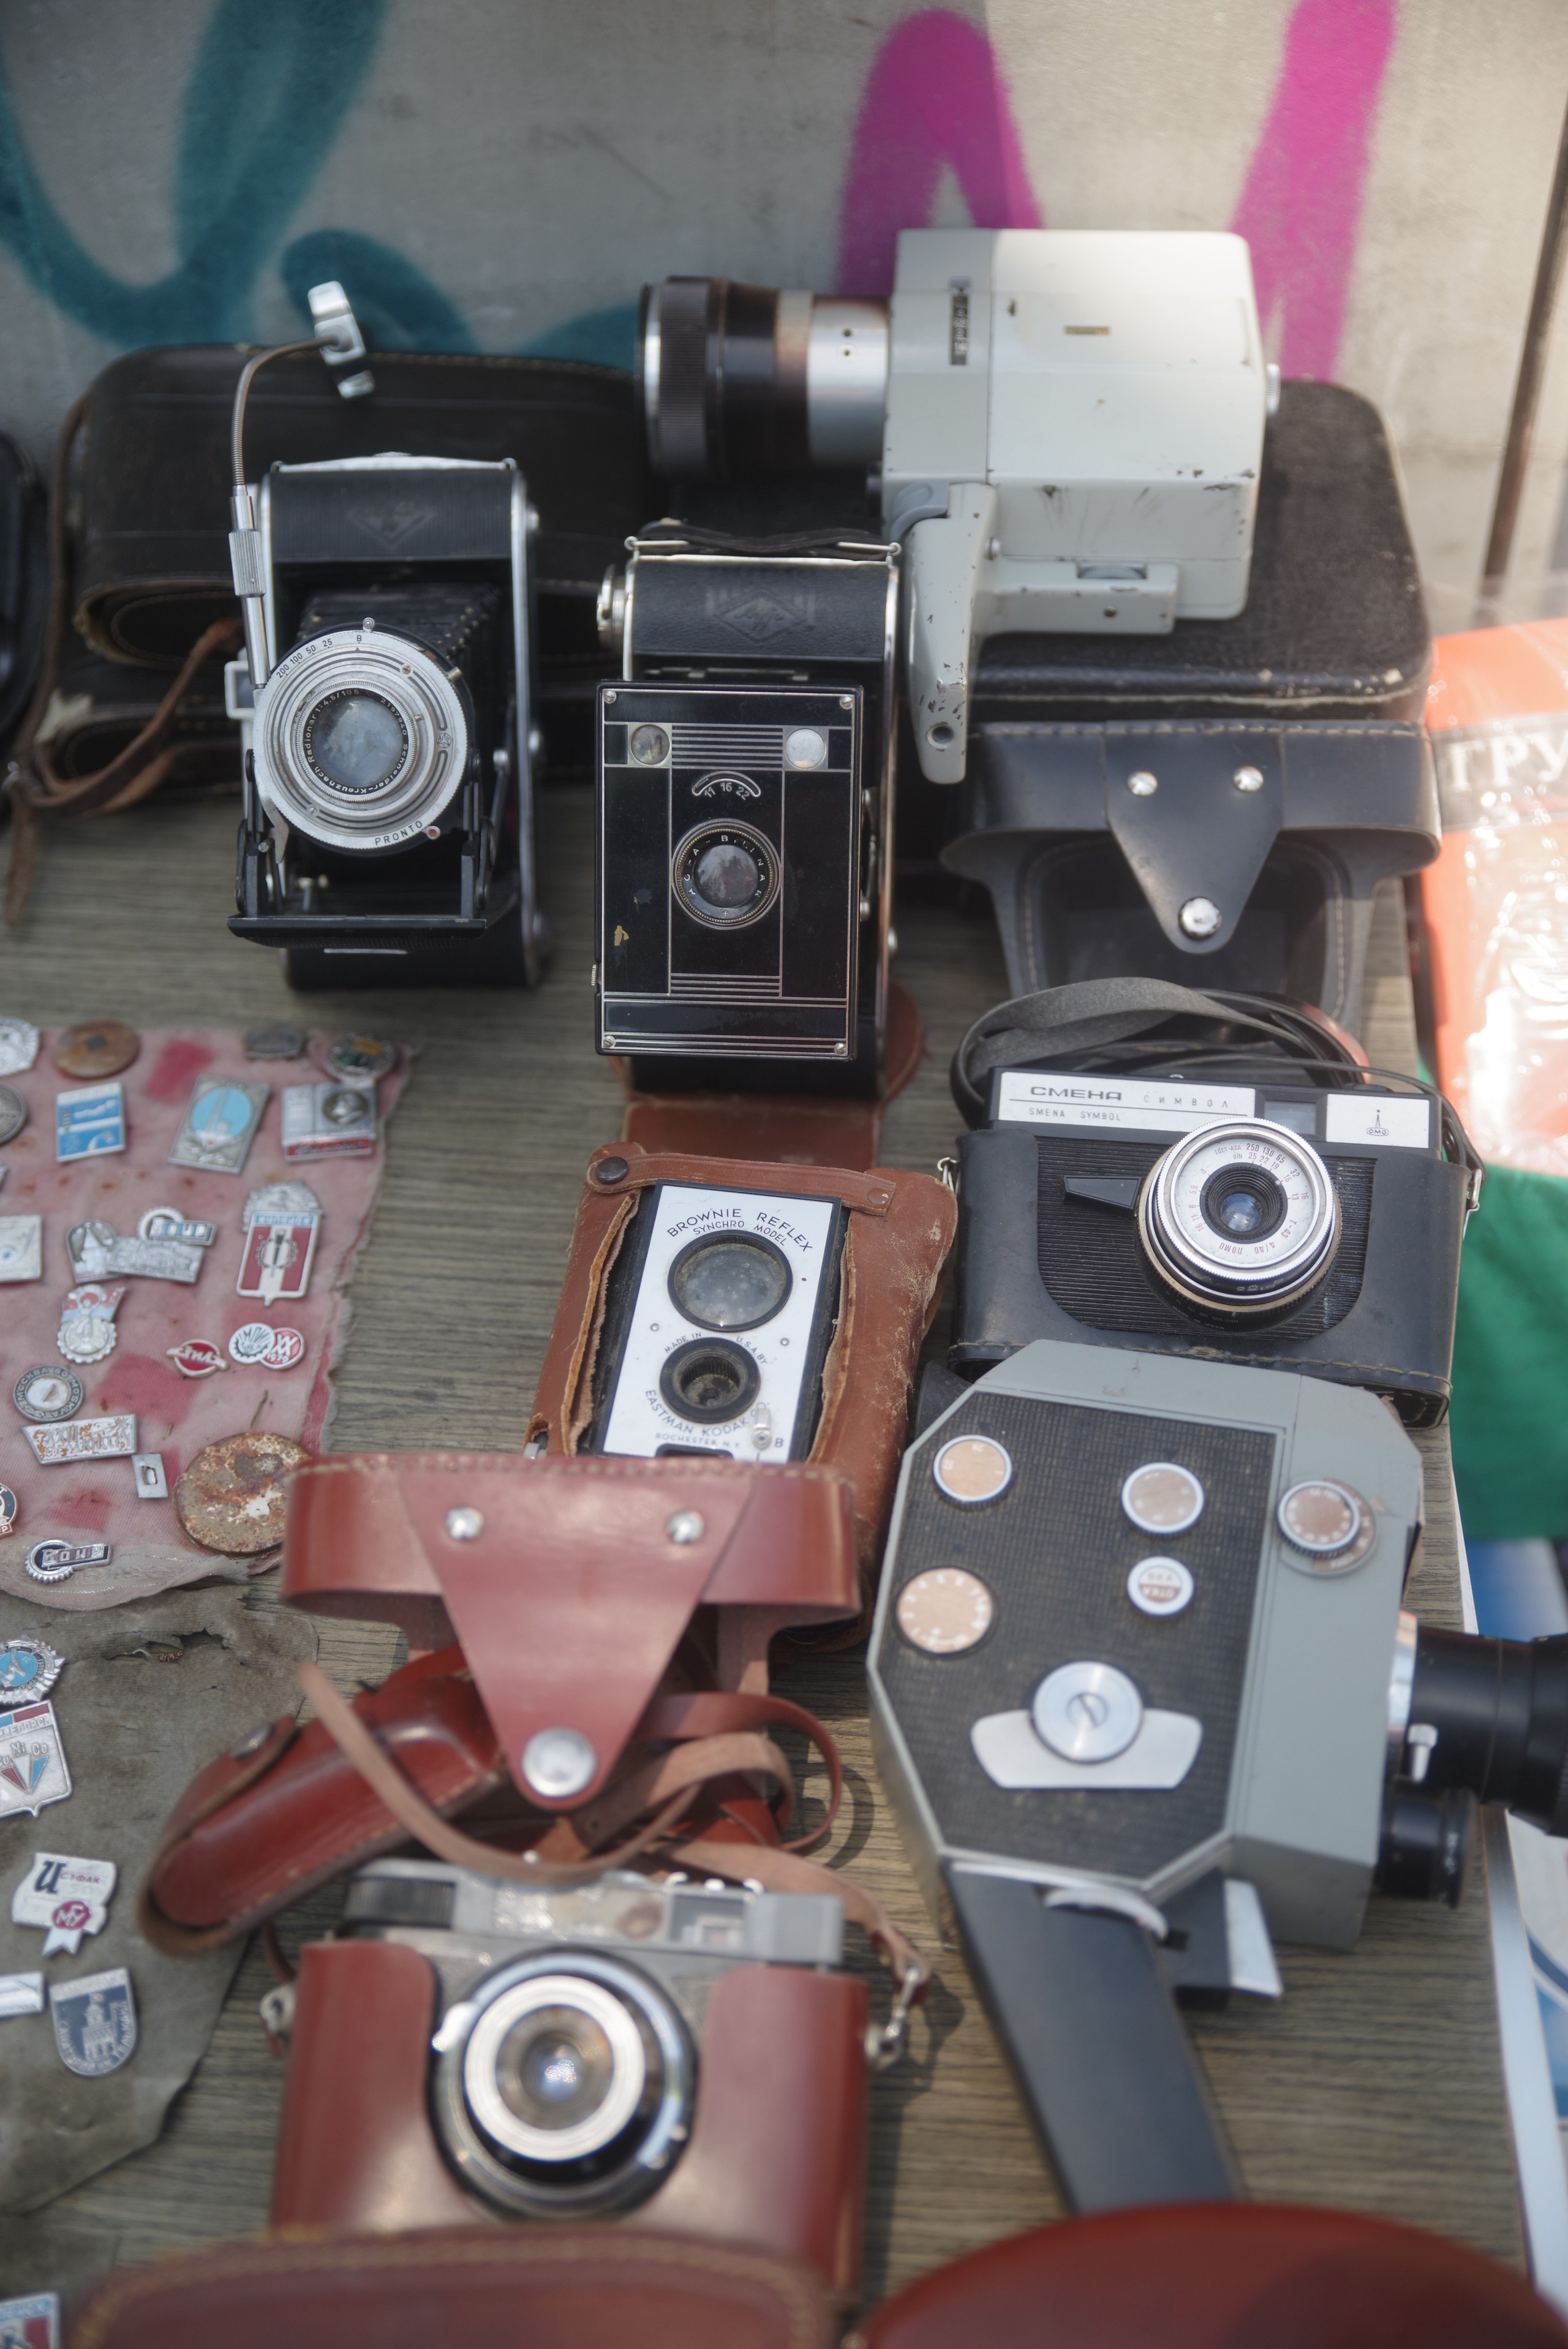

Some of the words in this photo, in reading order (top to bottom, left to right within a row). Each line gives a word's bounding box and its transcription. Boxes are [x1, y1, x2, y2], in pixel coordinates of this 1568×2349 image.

[276, 664, 290, 678] 200
[290, 653, 303, 665] 100
[306, 645, 316, 654] 50
[322, 638, 333, 647] 25
[704, 786, 715, 797] 11
[720, 782, 733, 792] 16
[736, 786, 750, 800] 22
[375, 820, 423, 846] PRONTO
[1030, 1087, 1123, 1101] СМЕНА
[1144, 1095, 1229, 1109] СИМВОЛ
[1029, 1107, 1065, 1118] SMENA
[1080, 1111, 1121, 1121] SYMBOL
[1246, 1143, 1259, 1152] 250
[1263, 1147, 1275, 1157] 130
[1276, 1154, 1286, 1164] 65
[1290, 1168, 1300, 1178] 32
[667, 1208, 741, 1237] BROWNIE
[756, 1212, 813, 1252] REFLEX
[693, 1220, 745, 1235] SYNCHRO
[753, 1224, 785, 1246] MODEL
[664, 1335, 688, 1354] MADE
[646, 1389, 694, 1434] EASTMAN
[702, 1417, 750, 1436] KODAK
